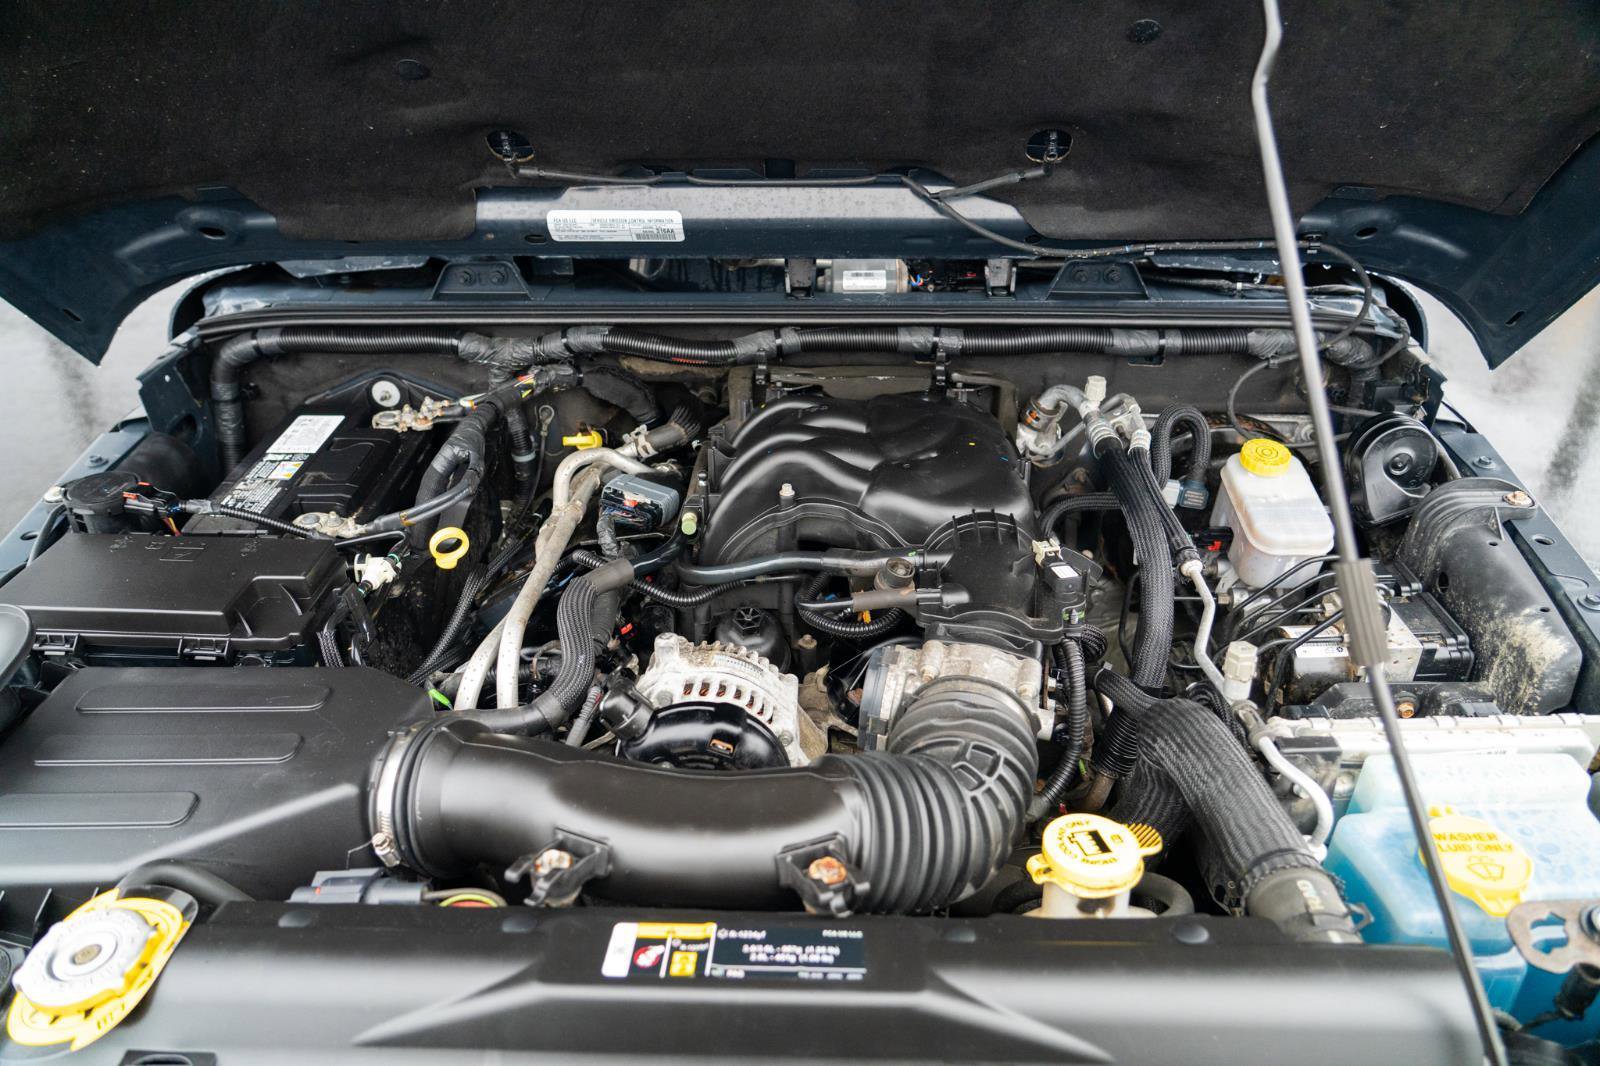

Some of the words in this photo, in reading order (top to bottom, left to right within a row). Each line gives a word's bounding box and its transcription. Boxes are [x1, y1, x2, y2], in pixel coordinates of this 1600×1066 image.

[1433, 832, 1498, 841] WASHER
[1437, 843, 1472, 853] LUID
[1476, 843, 1514, 853] ONLY
